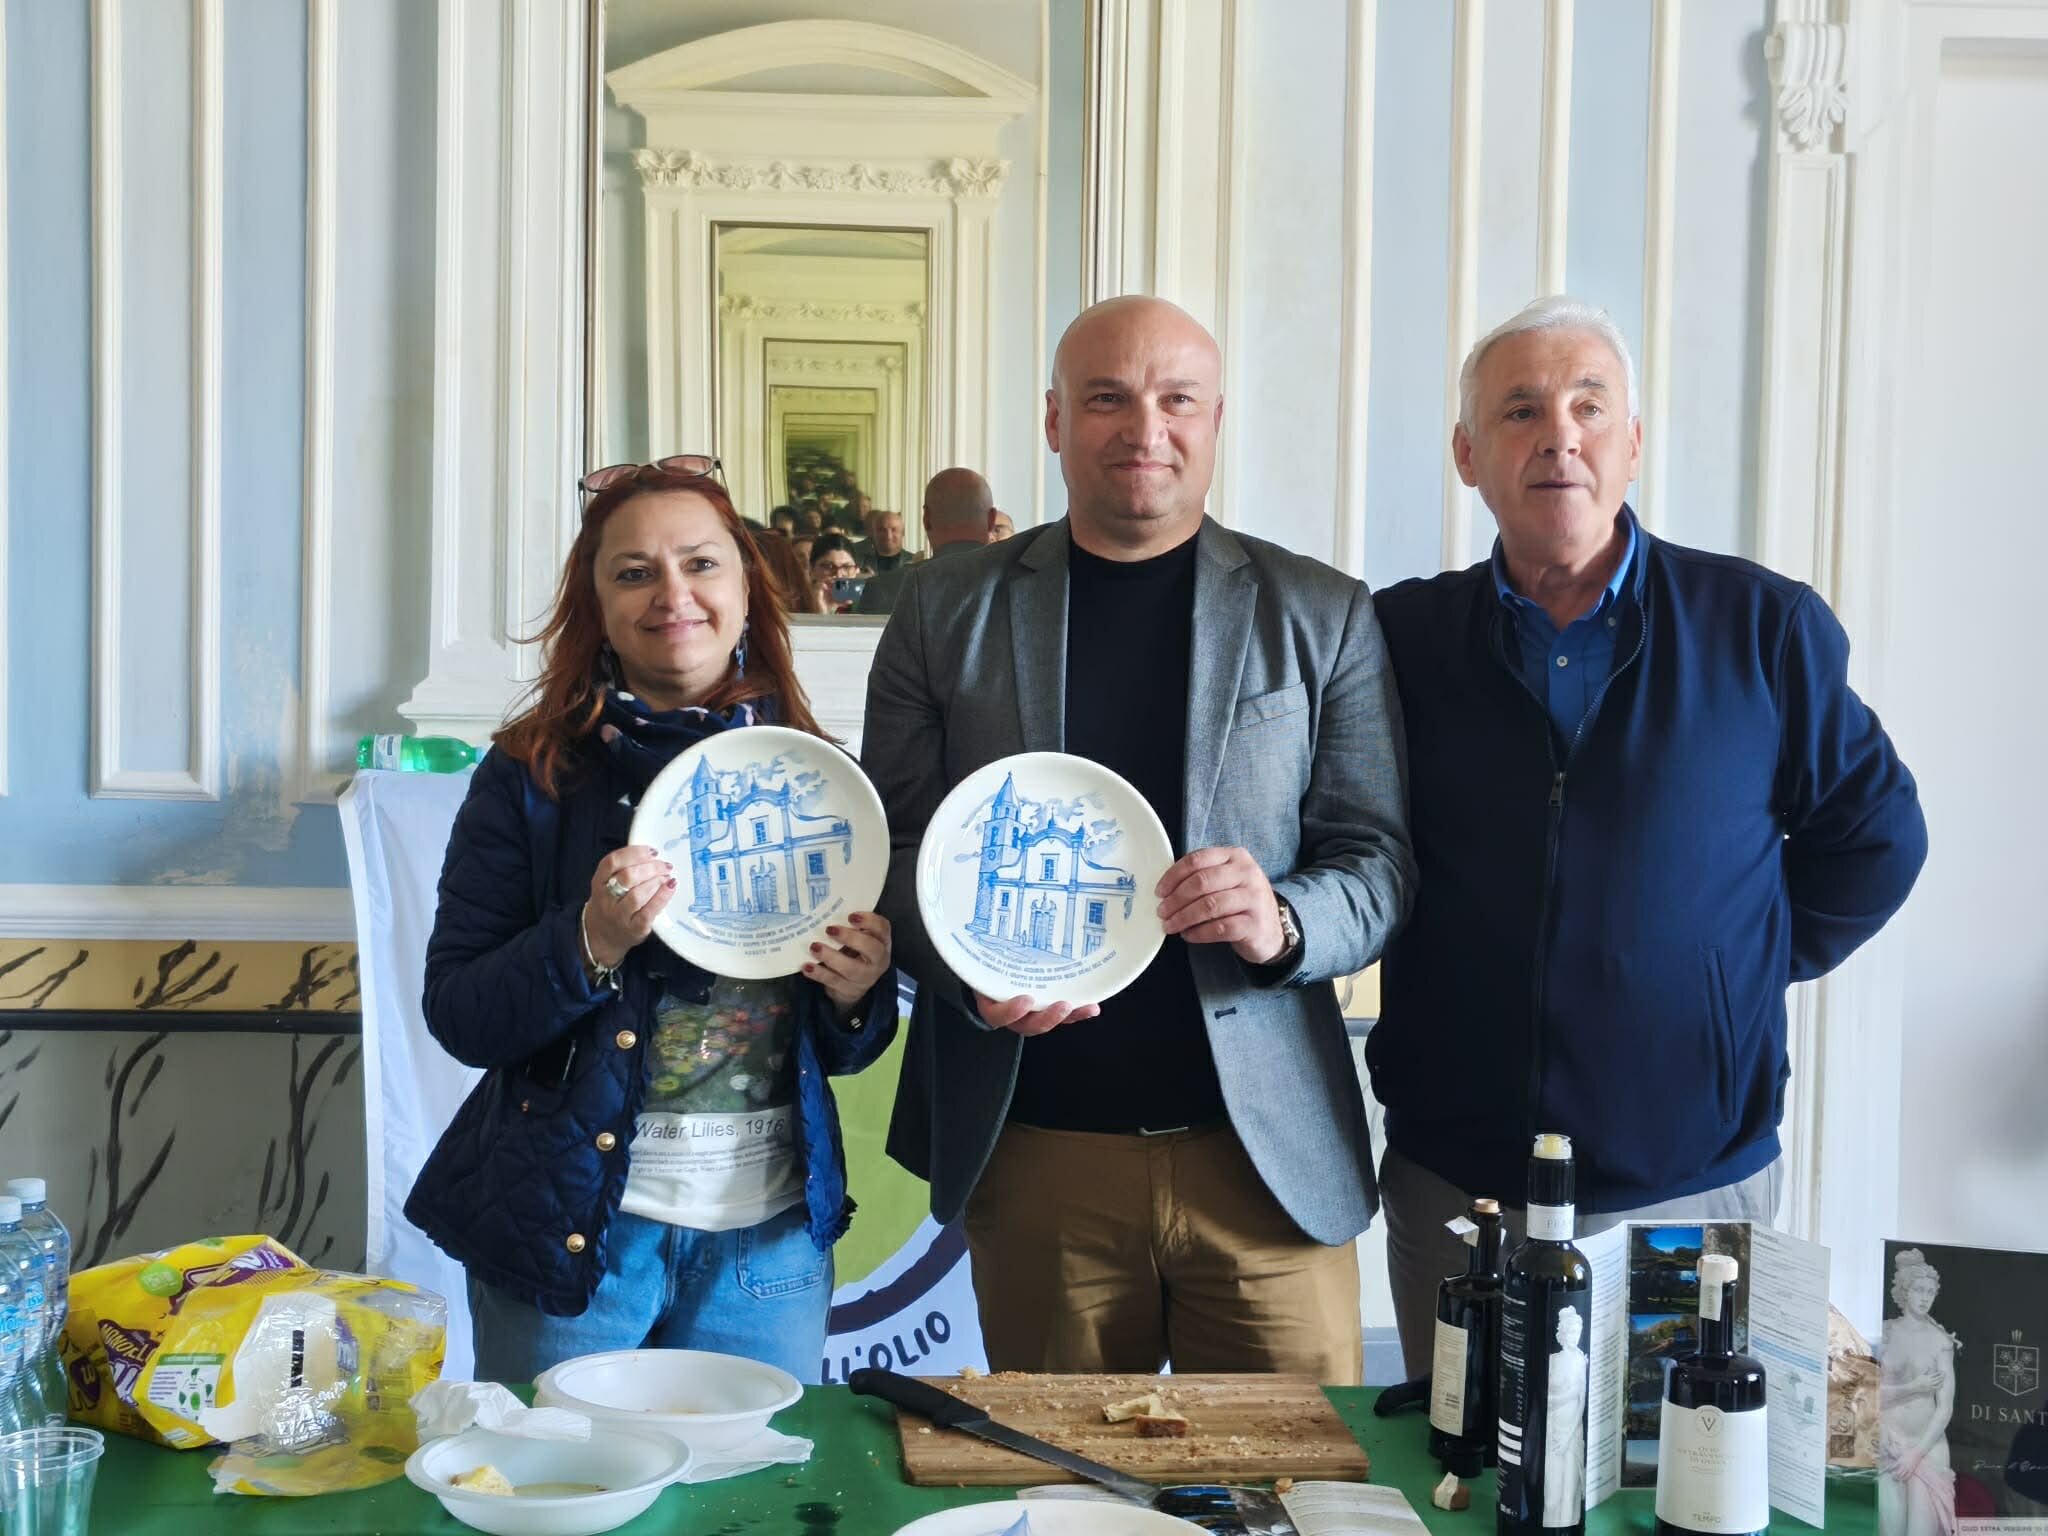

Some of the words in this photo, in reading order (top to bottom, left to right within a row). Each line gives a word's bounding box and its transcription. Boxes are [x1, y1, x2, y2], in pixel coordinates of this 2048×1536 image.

[637, 1120, 688, 1140] Water
[691, 1121, 740, 1138] Lilies,
[745, 1117, 785, 1135] 1916
[1970, 1404, 1991, 1420] DI
